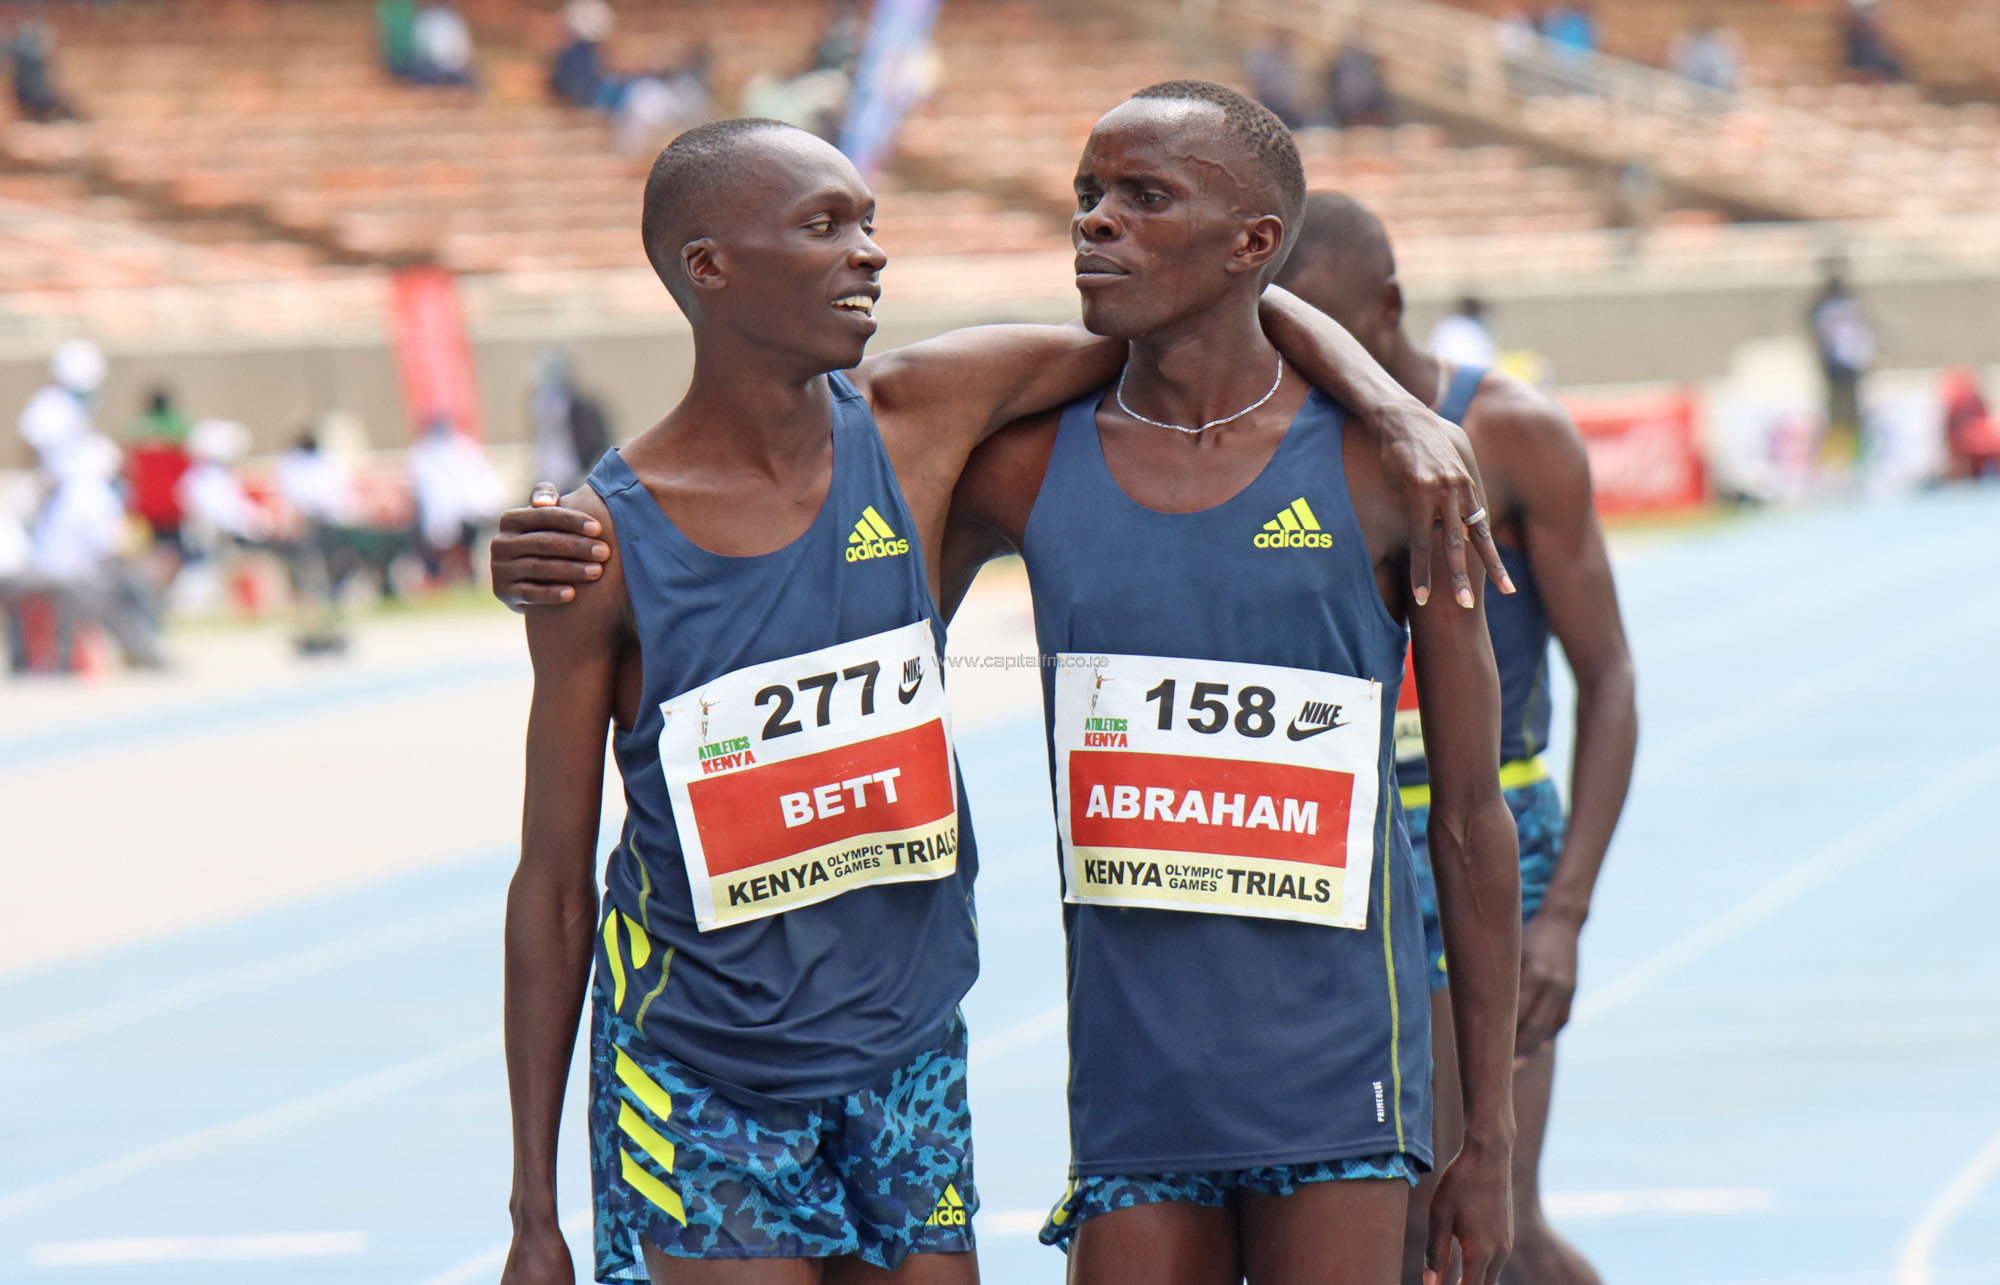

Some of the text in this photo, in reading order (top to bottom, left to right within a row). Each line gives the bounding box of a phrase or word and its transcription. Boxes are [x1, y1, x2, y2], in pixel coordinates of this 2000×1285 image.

[845, 538, 909, 563] adidas
[1253, 529, 1333, 549] adidas
[903, 656, 922, 684] NIKE
[754, 660, 880, 741] 277
[1146, 679, 1276, 738] 158
[1084, 717, 1128, 732] ATHLETICS
[1299, 701, 1342, 726] NIKE
[698, 736, 751, 760] ATHLETICS
[1084, 732, 1128, 748] KENYA
[701, 750, 756, 775] KENYA
[779, 767, 901, 828] BETT
[1085, 784, 1319, 835] ABRAHAM
[728, 827, 957, 906] KENYA OLYMPIC TRIALS
[834, 857, 881, 878] GAMES
[1084, 859, 1331, 903] KENYA OLYMPIC TRIALS
[1169, 878, 1218, 892] GAMES
